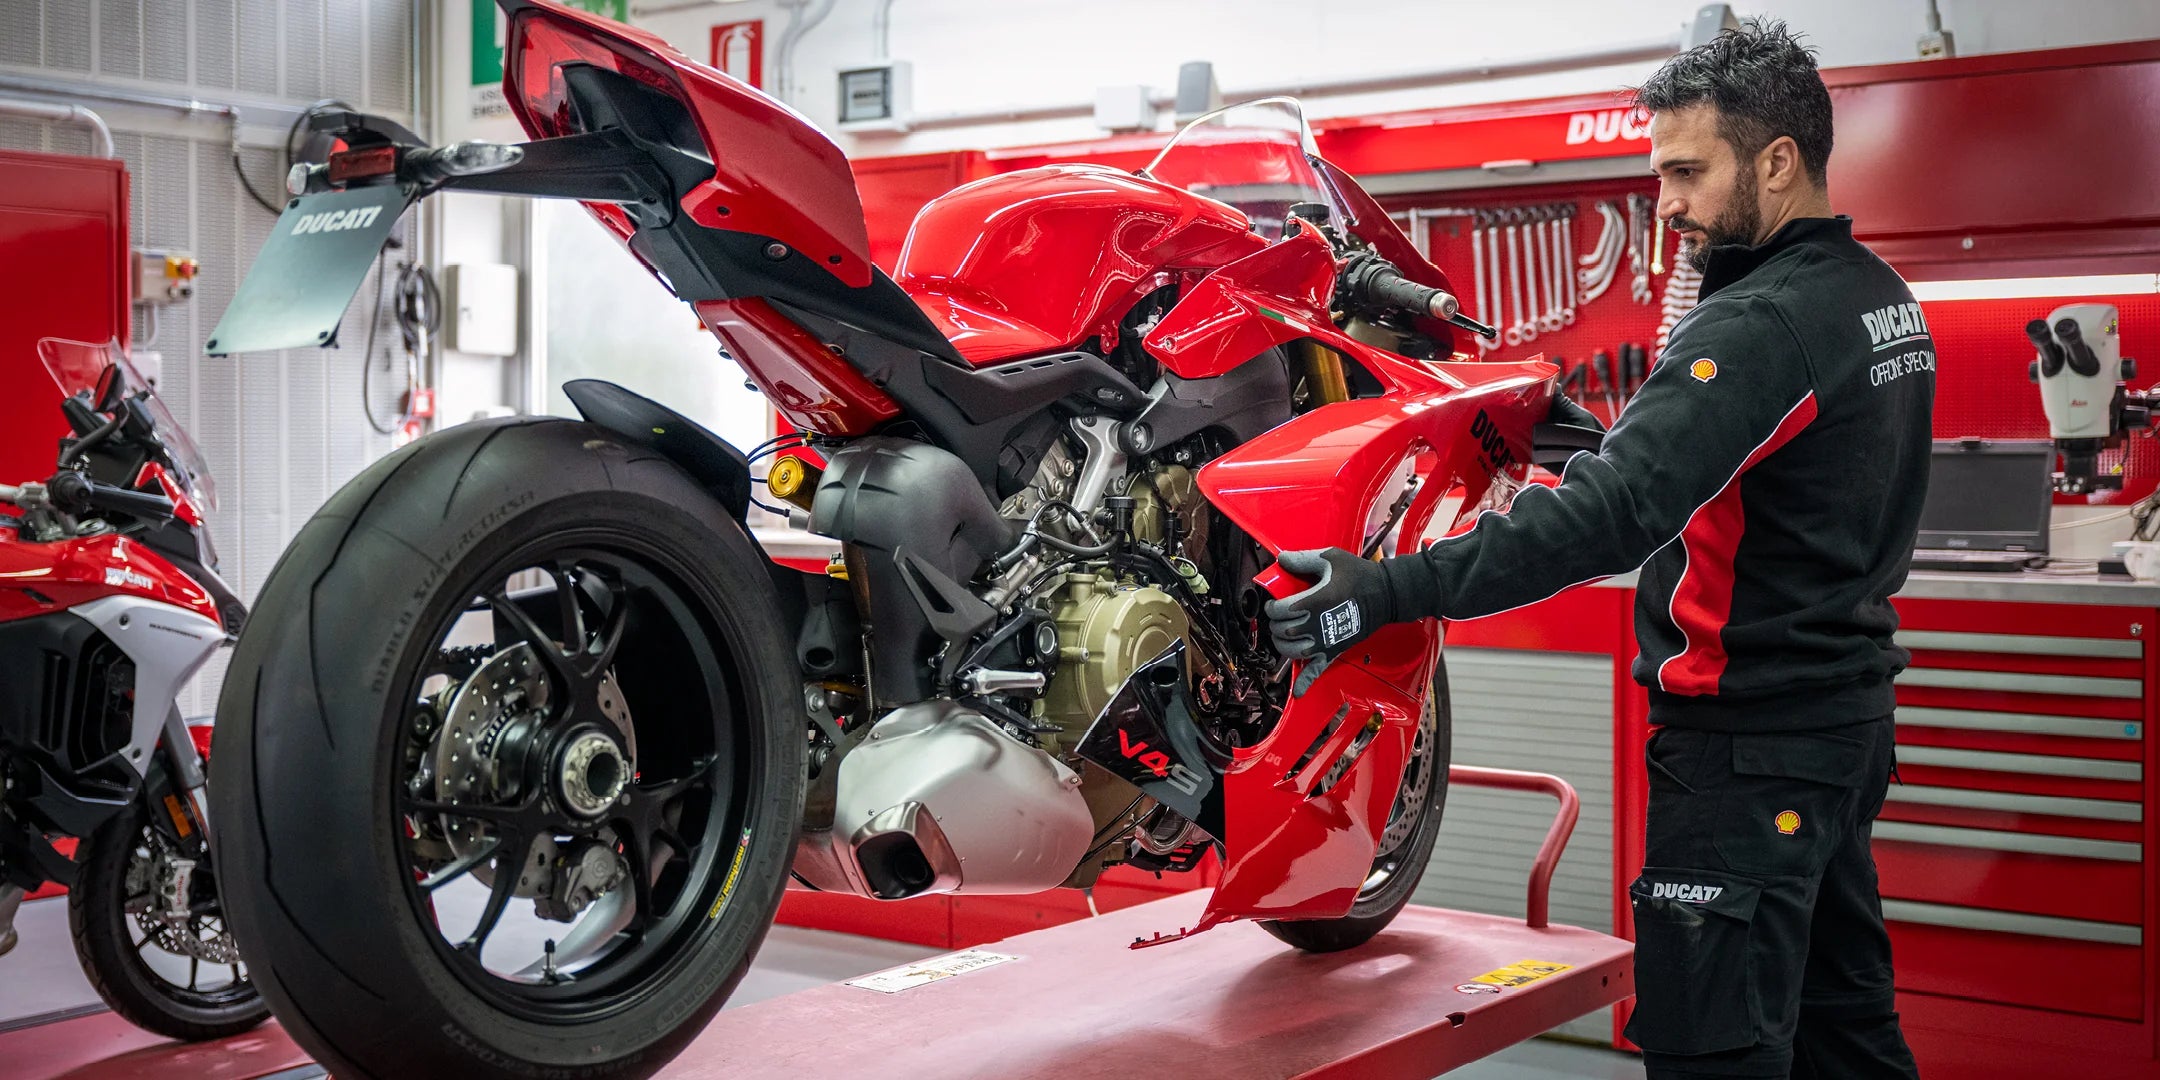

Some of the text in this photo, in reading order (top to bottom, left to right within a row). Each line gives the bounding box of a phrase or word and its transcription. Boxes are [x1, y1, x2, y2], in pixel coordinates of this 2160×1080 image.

[1565, 109, 1652, 146] DUC
[291, 205, 383, 235] DUCATI
[1861, 302, 1928, 346] DUCATI
[1652, 882, 1723, 901] DUCATI
